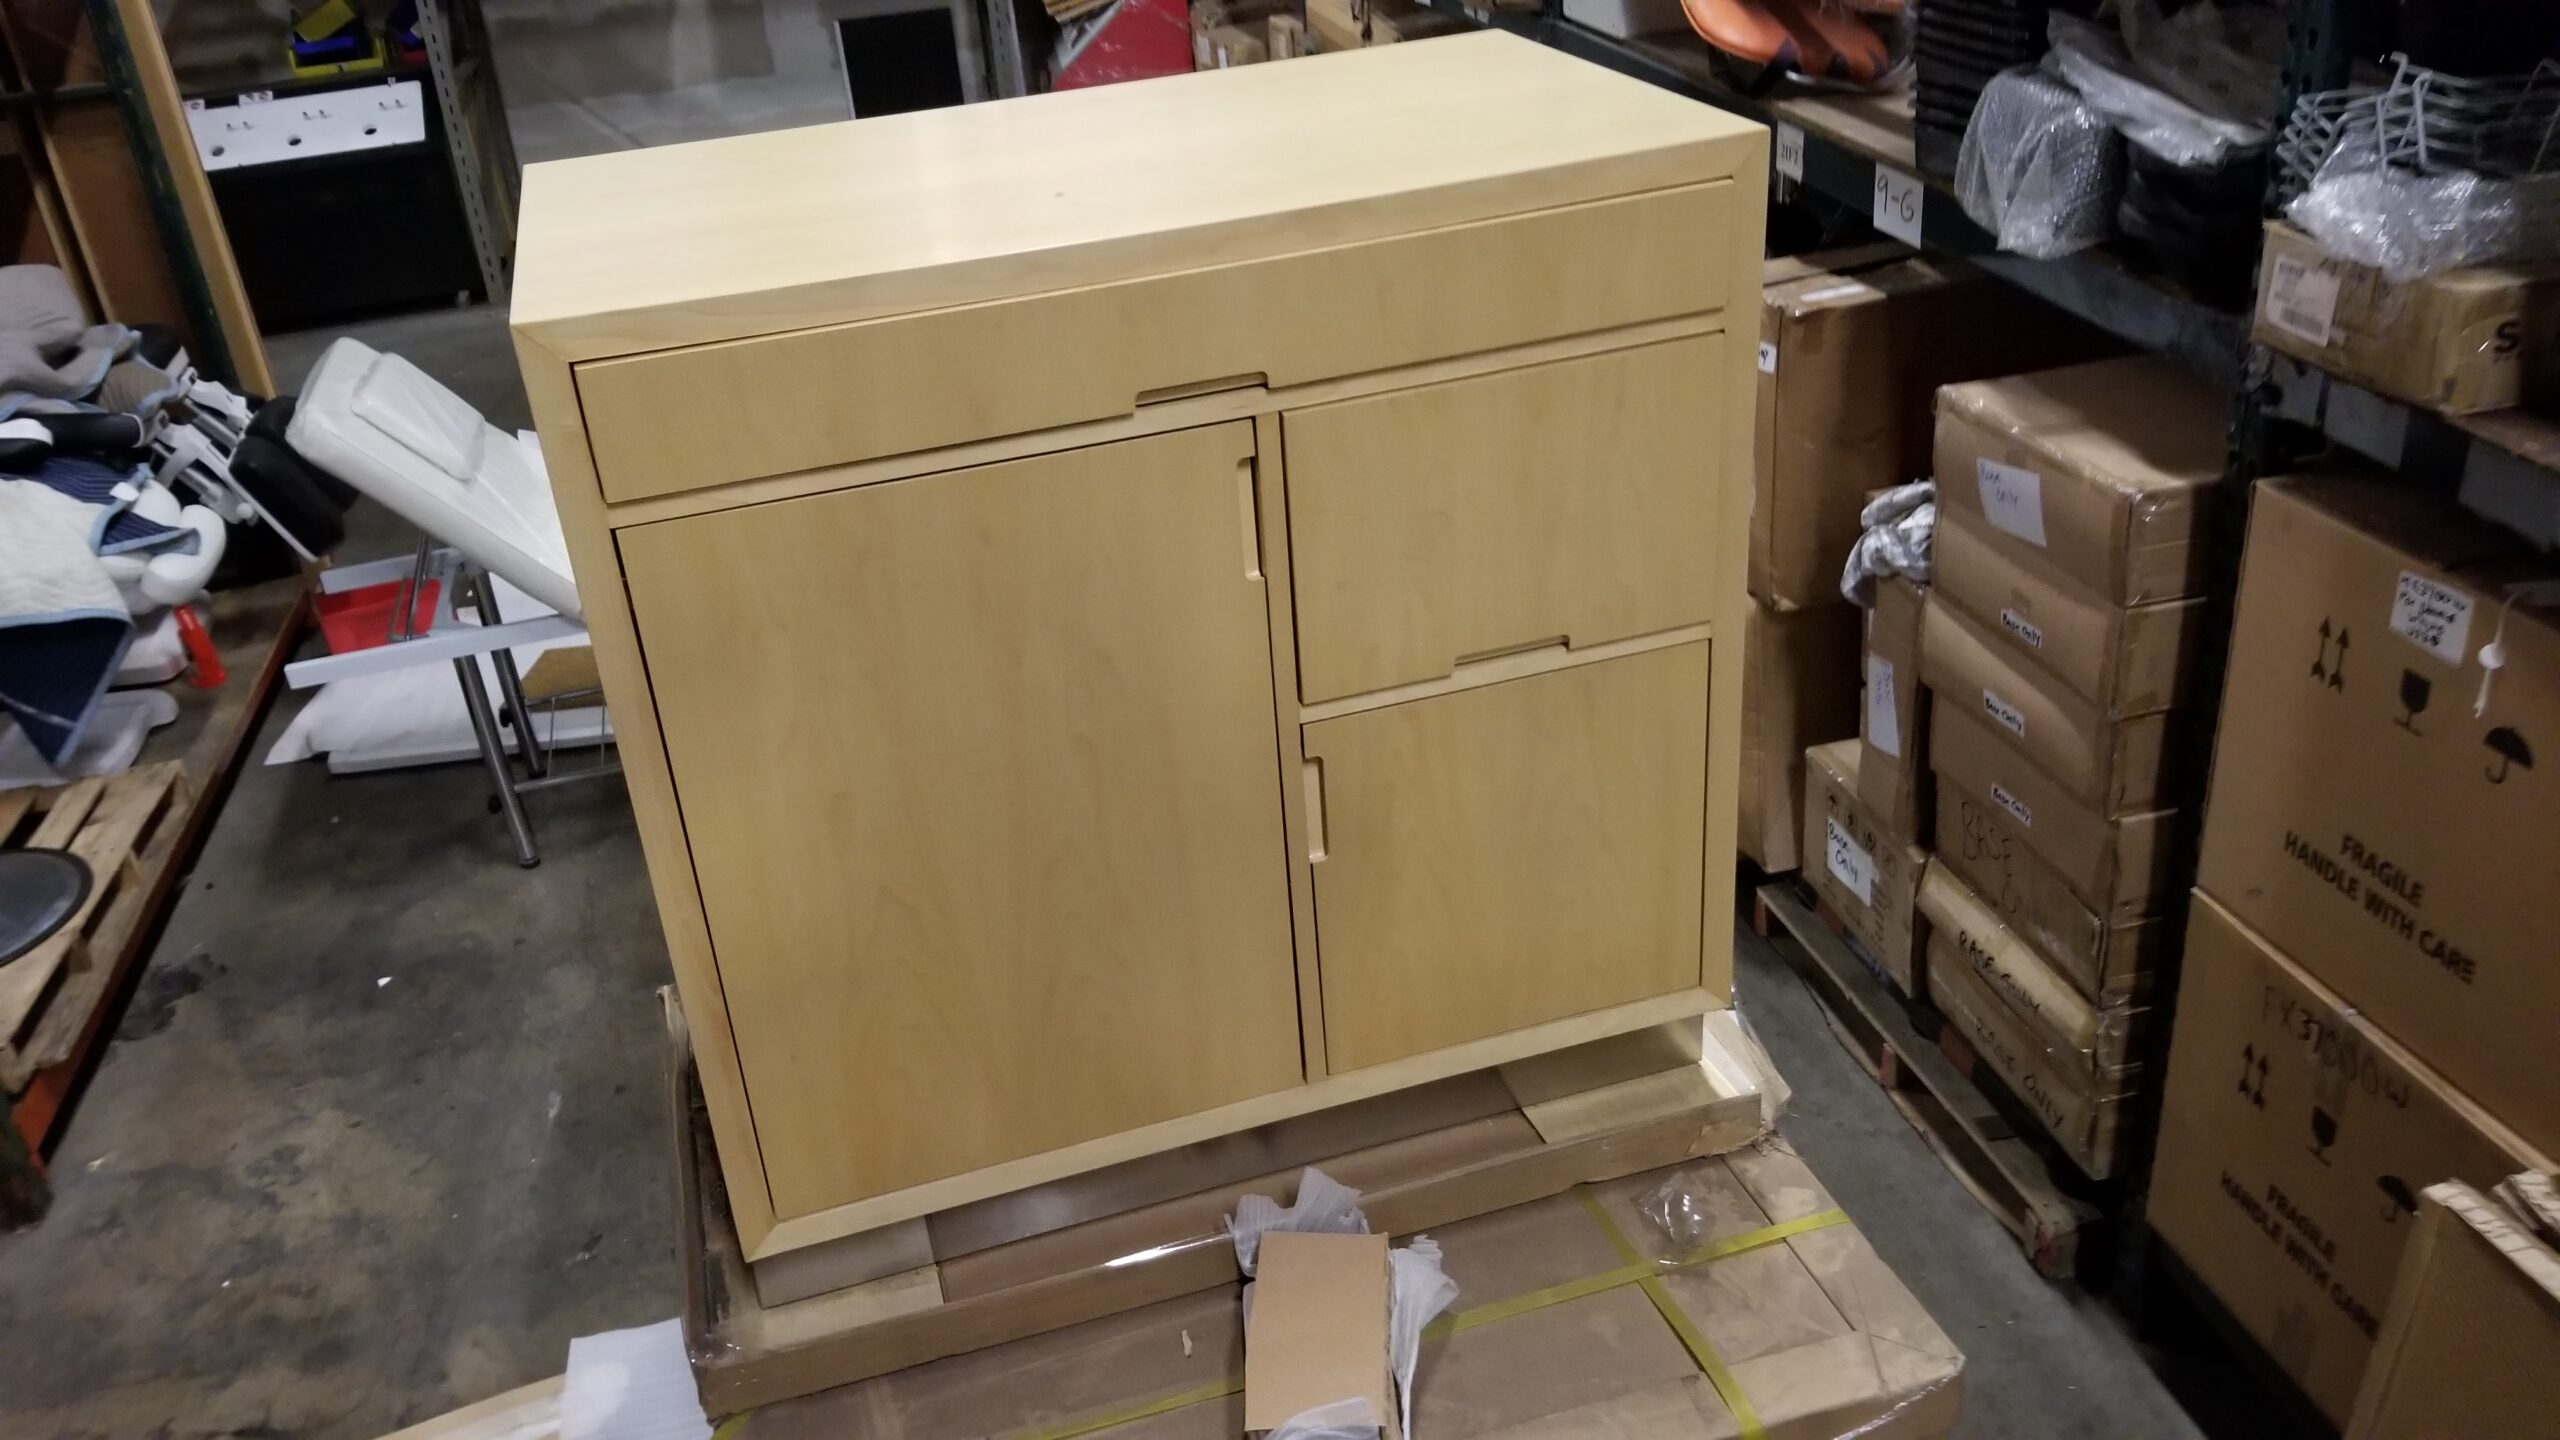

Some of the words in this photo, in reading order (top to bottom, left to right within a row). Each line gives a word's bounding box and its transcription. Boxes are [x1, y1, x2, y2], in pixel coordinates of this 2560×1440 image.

[2283, 829, 2360, 902] HANDLE
[2364, 887, 2416, 942] WITH
[2418, 929, 2477, 986] CARE
[2341, 833, 2425, 909] FRAGILE
[2220, 1169, 2283, 1246] HANDLE
[2286, 1234, 2331, 1291] WITH
[2267, 1184, 2336, 1265] FRAGILE
